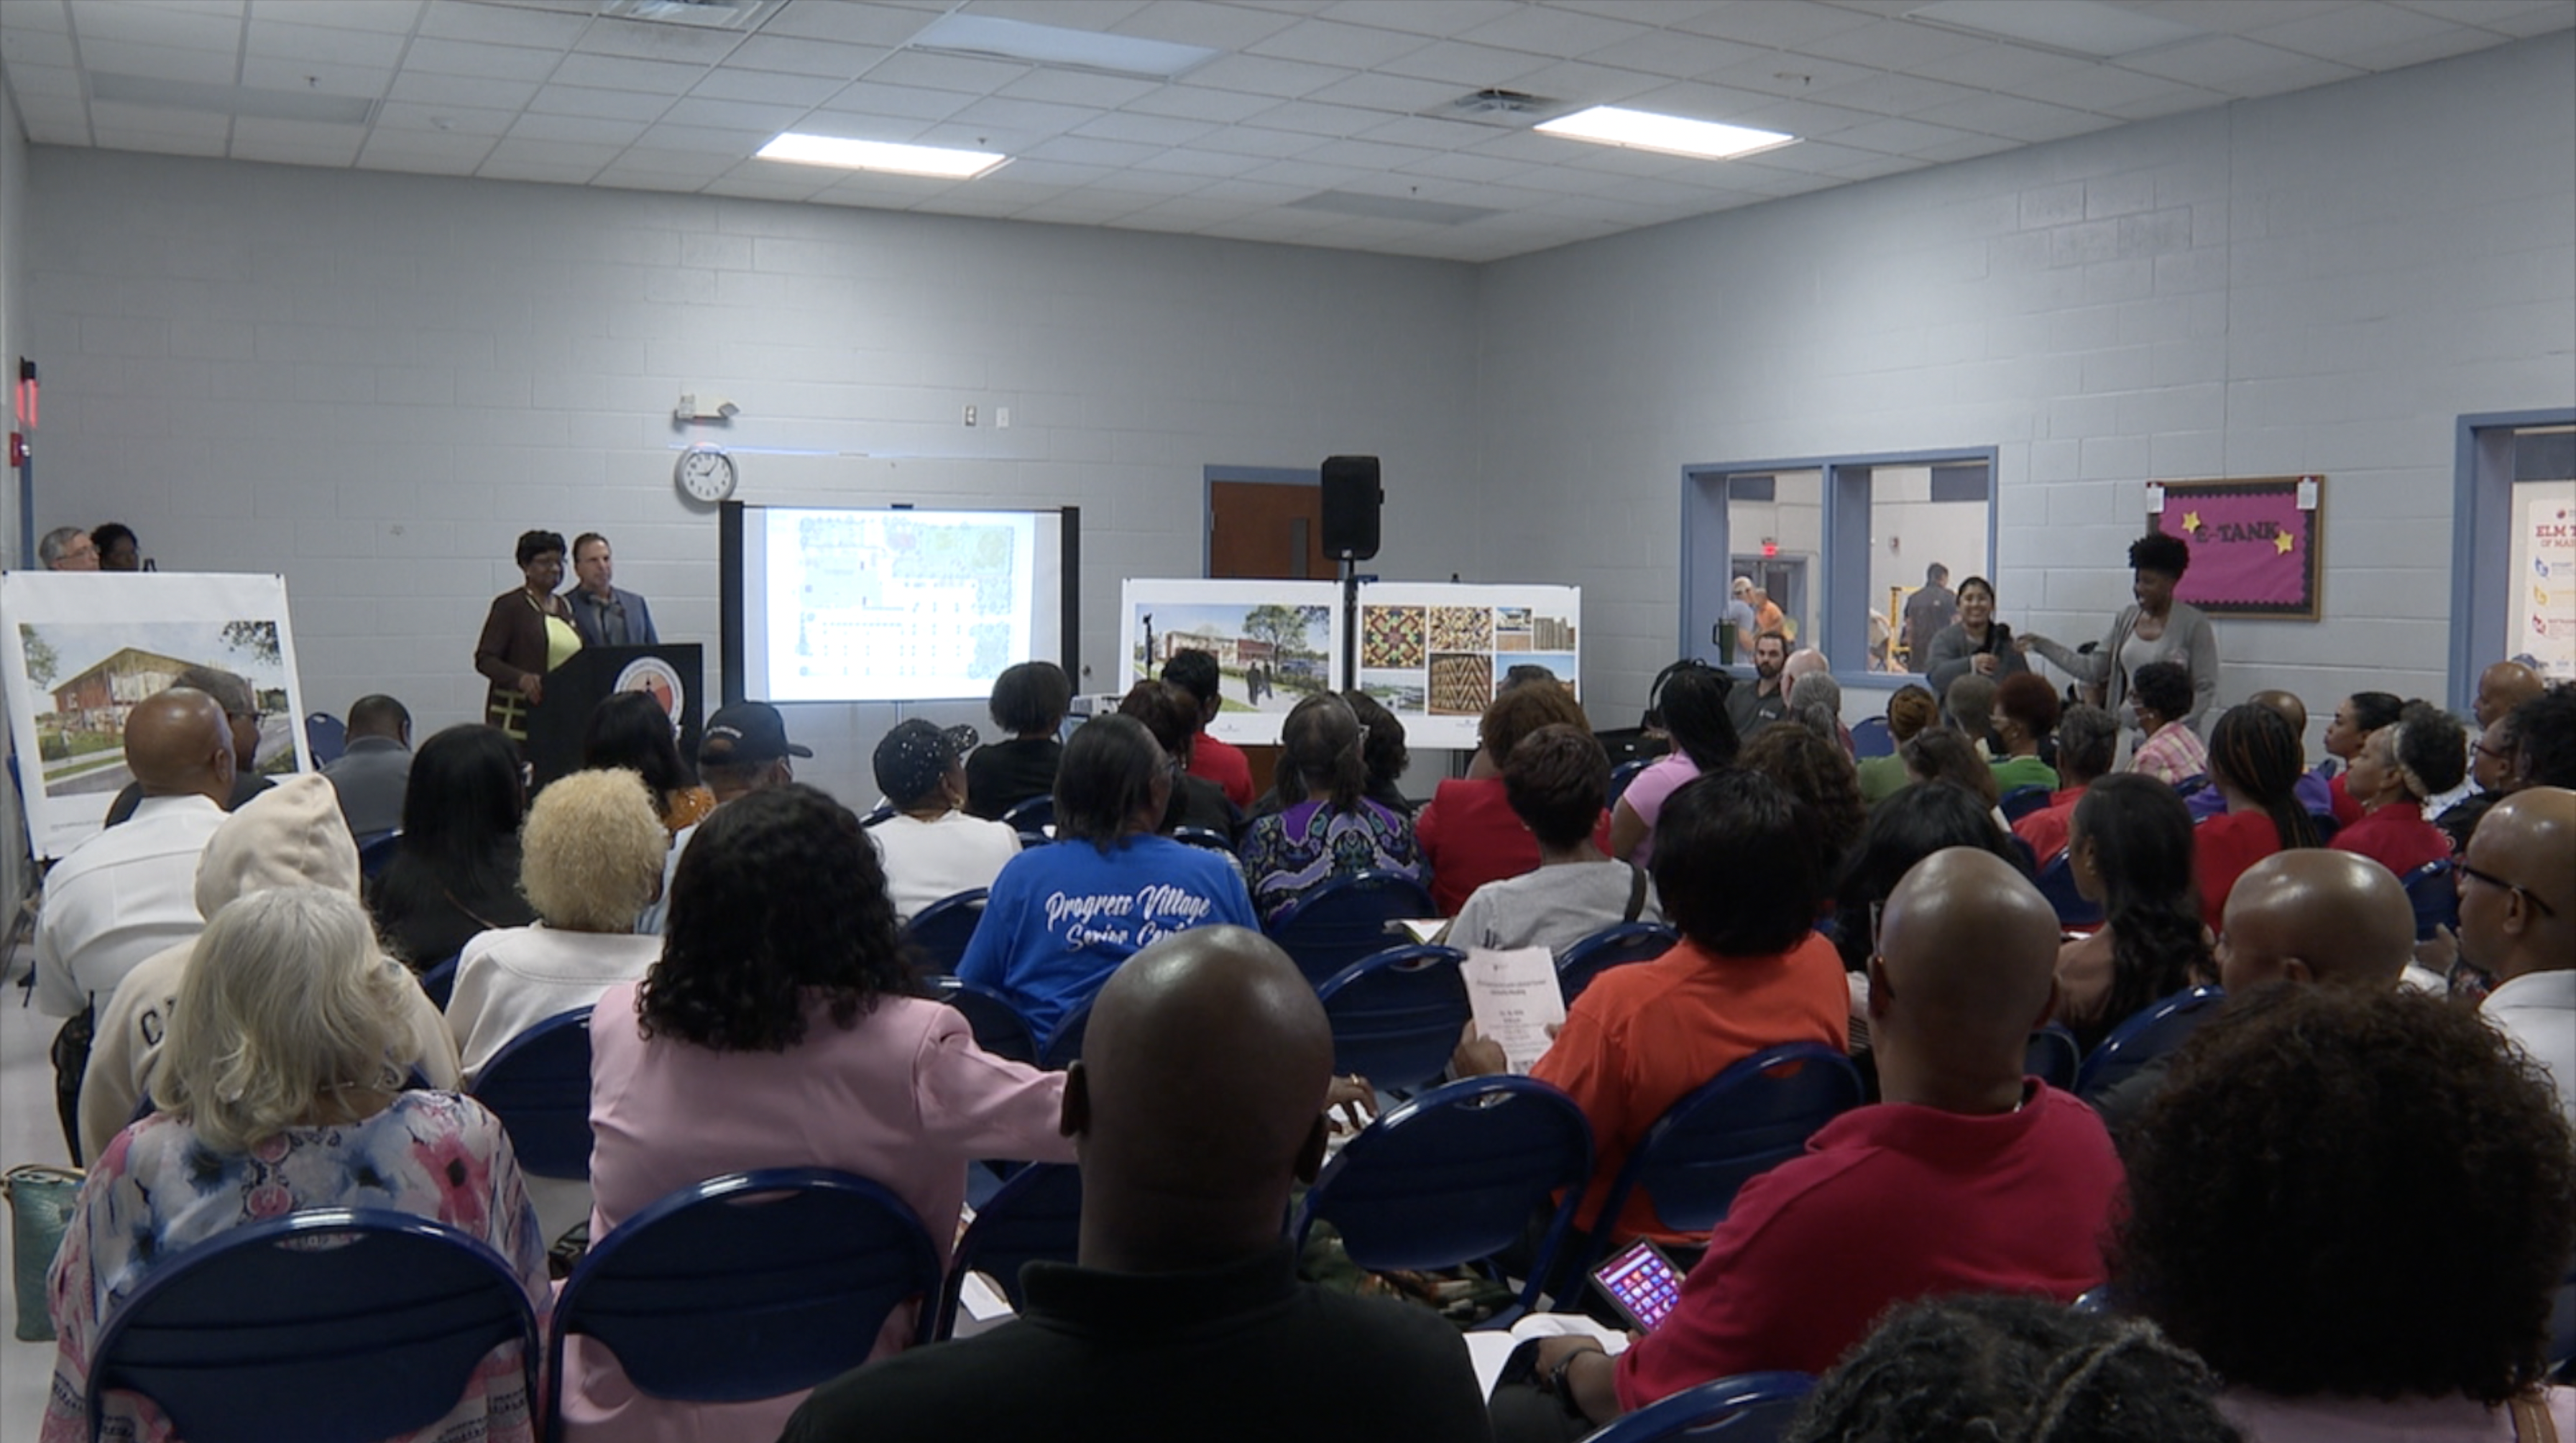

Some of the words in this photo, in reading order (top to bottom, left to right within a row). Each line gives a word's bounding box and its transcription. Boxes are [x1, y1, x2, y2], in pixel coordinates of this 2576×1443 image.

[2195, 521, 2279, 543] E-TANK
[2536, 525, 2566, 537] ELM
[1045, 890, 1133, 932] Progress
[1136, 884, 1210, 924] Village
[1066, 923, 1128, 952] Senior
